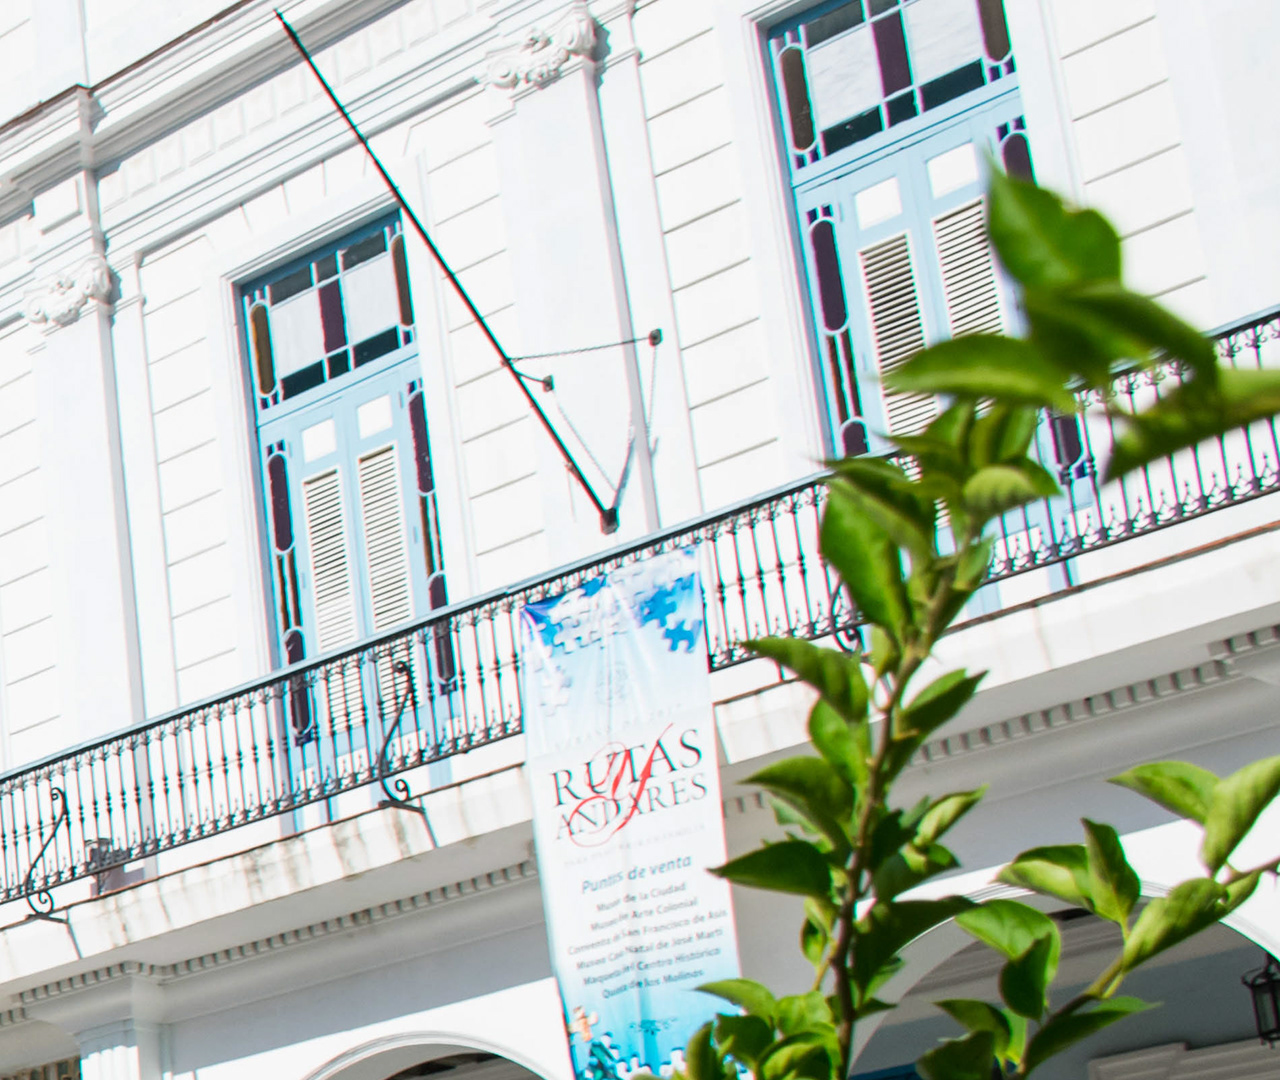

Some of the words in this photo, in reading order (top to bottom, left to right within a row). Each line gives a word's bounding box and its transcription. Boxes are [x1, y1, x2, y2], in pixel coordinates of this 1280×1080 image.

[549, 728, 703, 807] RUTAS
[555, 772, 709, 841] ANDARES
[627, 865, 647, 881] de
[649, 856, 692, 876] venta
